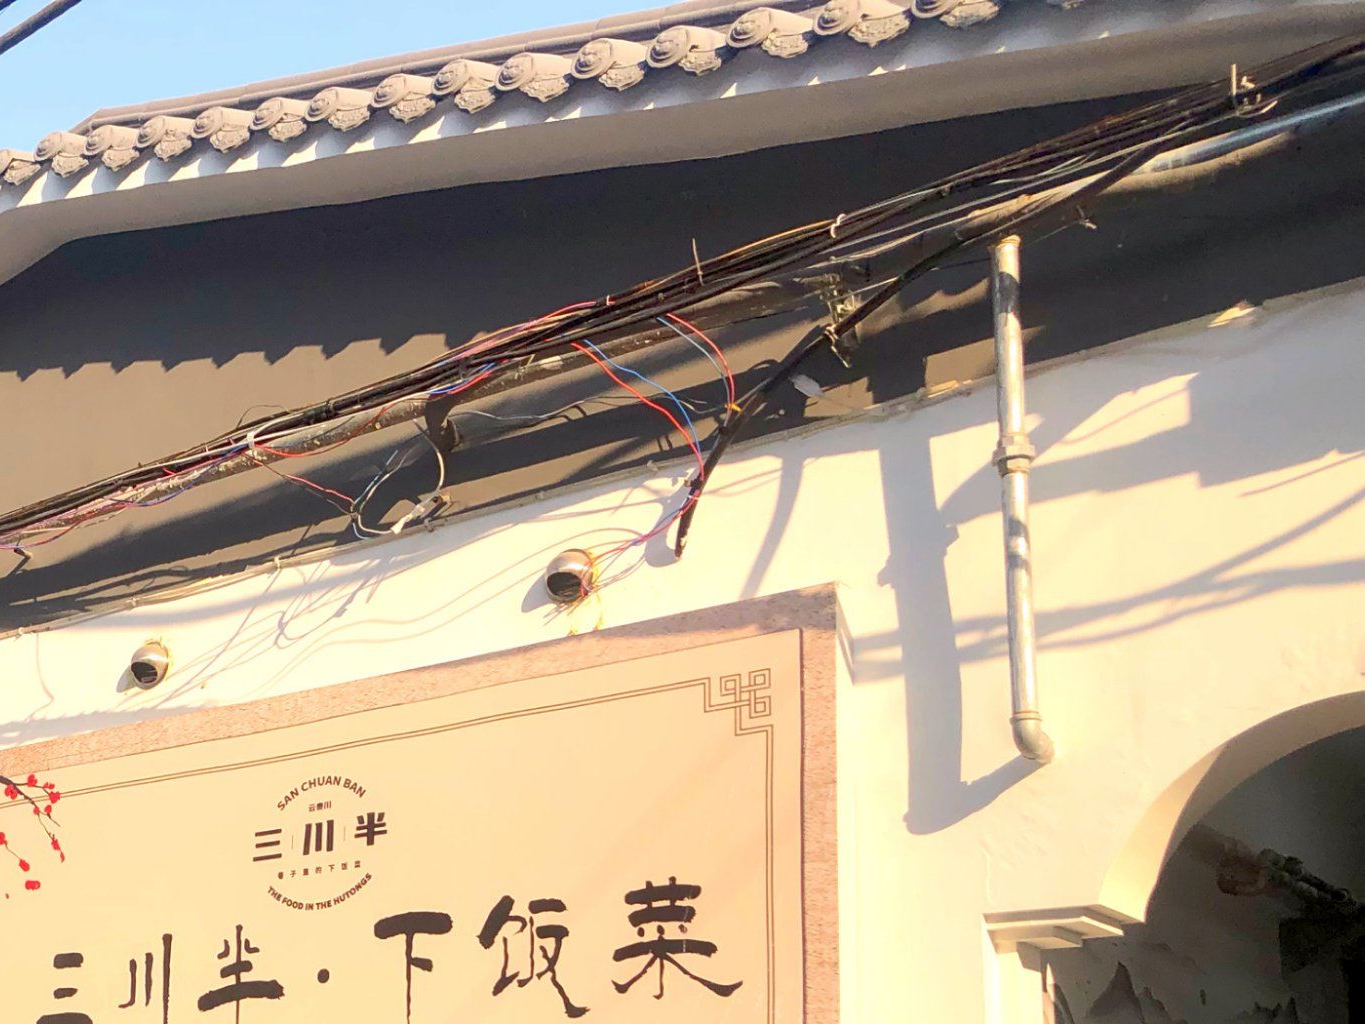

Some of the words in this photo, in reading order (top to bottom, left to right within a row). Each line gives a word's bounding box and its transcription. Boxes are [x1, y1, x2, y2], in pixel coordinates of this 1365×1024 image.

[277, 787, 300, 811] SAN
[300, 775, 342, 792] CHUAN
[342, 778, 367, 799] BAN
[252, 811, 388, 862] 三川半
[267, 885, 283, 901] THE
[281, 898, 304, 911] FOOD
[305, 902, 314, 911] IN
[315, 899, 333, 911] THE
[333, 872, 372, 906] HUTONGS
